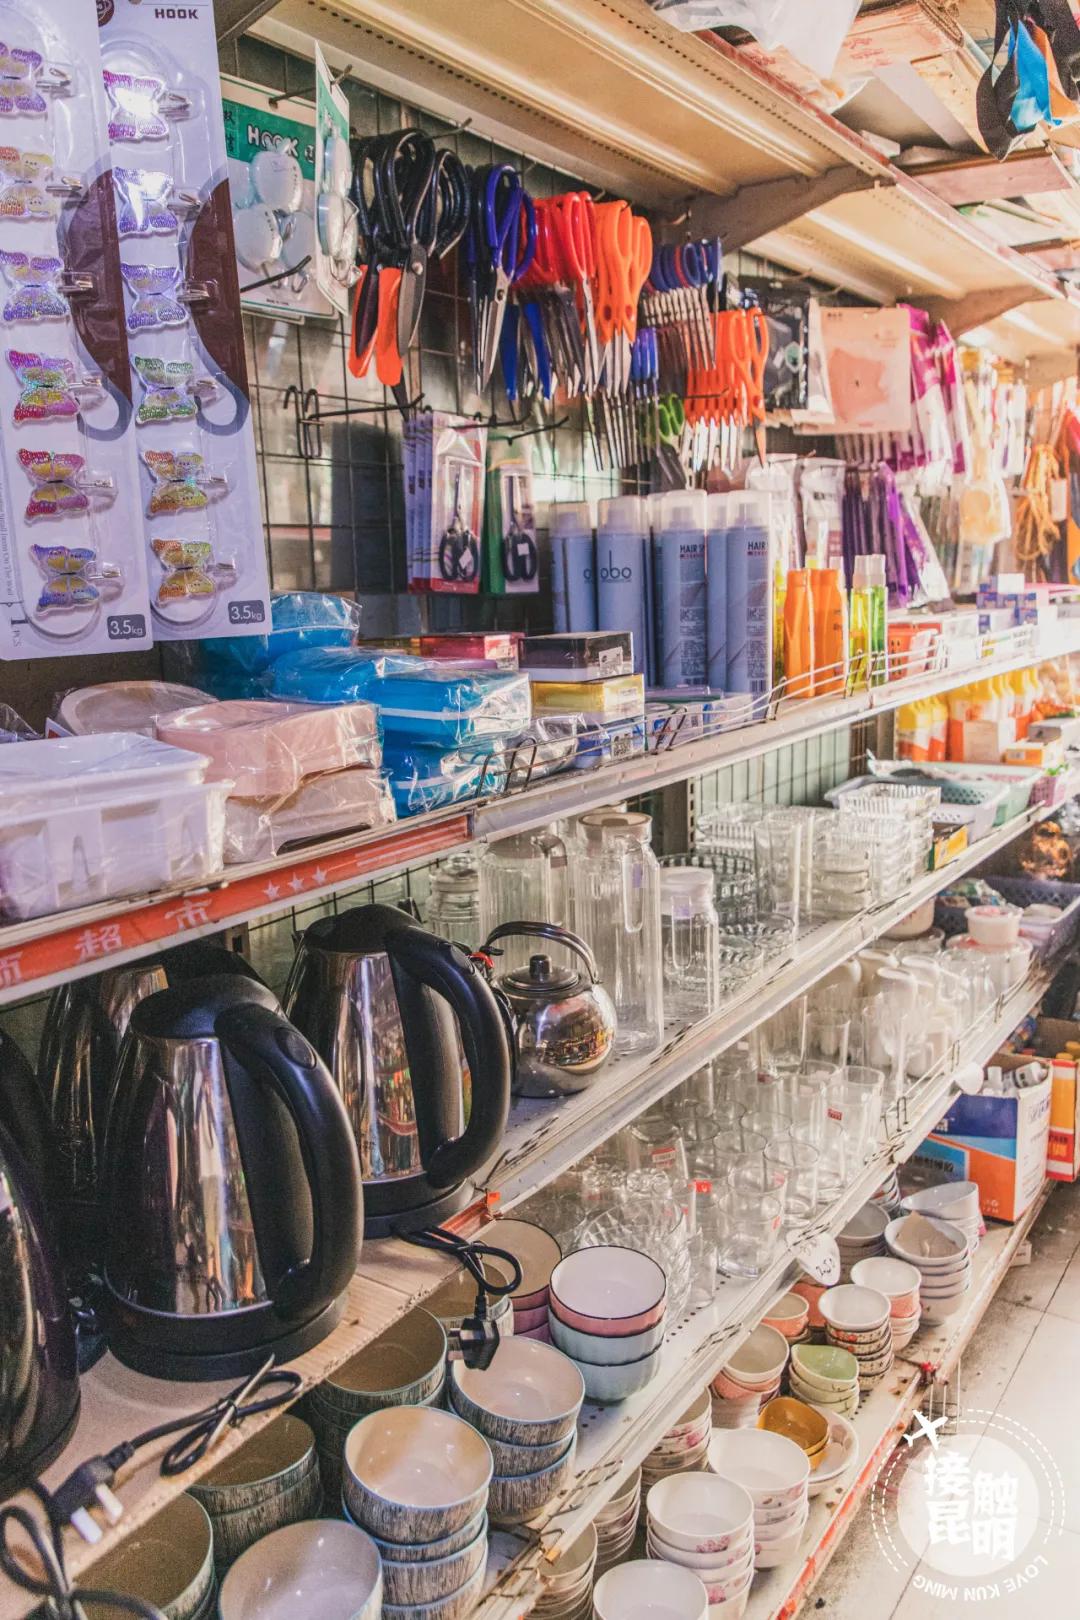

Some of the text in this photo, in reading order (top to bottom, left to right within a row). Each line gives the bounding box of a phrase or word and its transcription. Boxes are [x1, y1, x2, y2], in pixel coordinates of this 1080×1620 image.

[154, 8, 199, 19] HOOK
[679, 543, 697, 554] HAIR
[747, 541, 766, 550] HAIR
[230, 605, 263, 621] 3.5kg
[110, 620, 143, 636] 3.5kg
